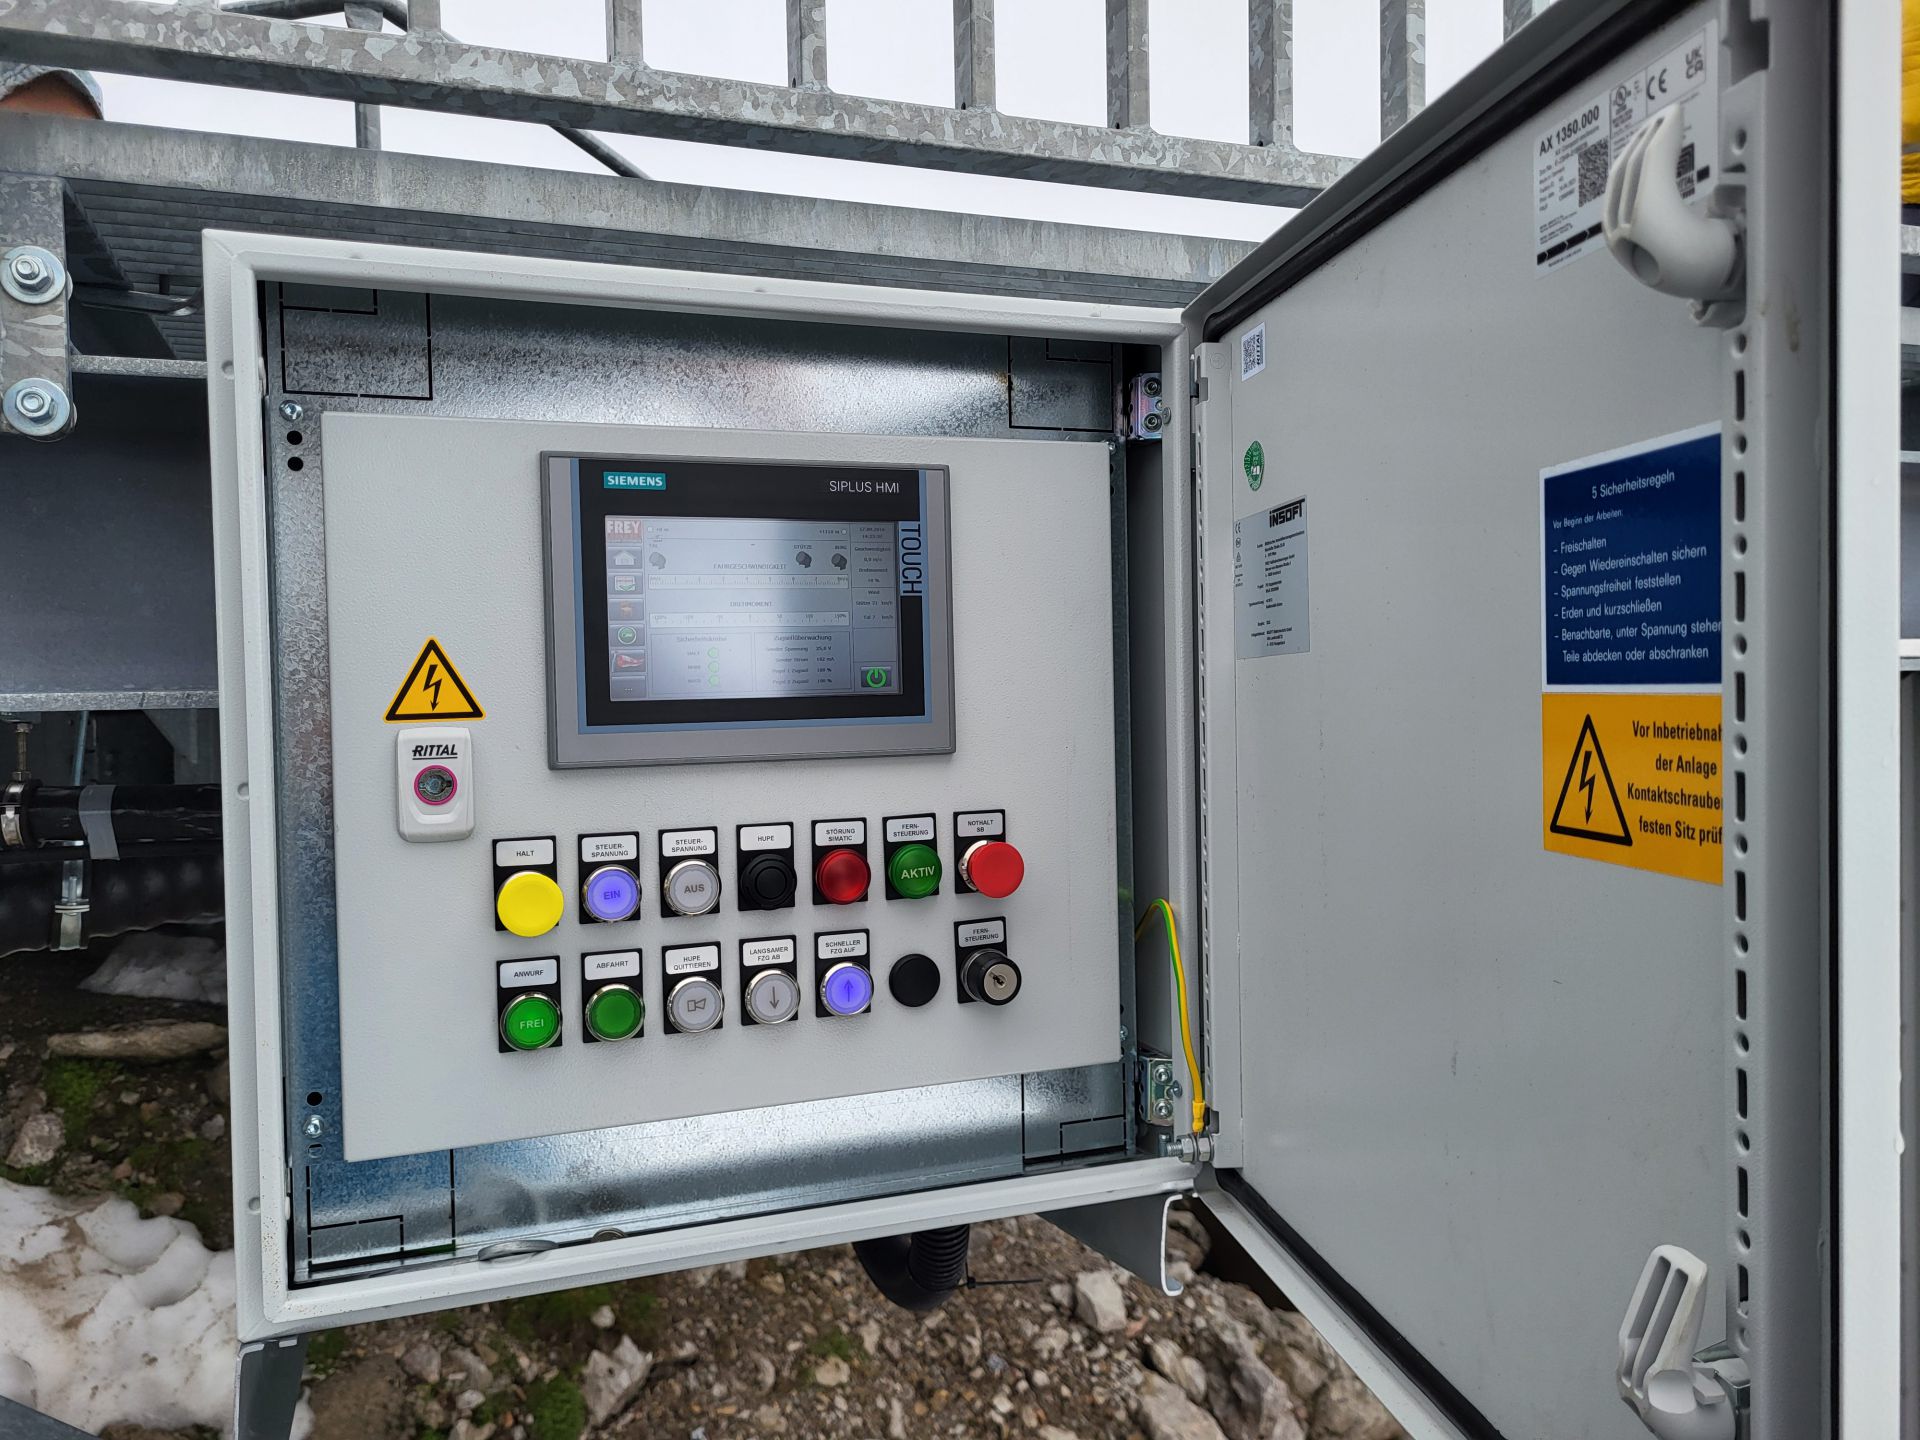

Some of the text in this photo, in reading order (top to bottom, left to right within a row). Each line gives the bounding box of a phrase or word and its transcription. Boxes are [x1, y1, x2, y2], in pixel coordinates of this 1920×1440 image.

[1647, 69, 1667, 100] CE
[1540, 136, 1552, 156] AX
[1556, 105, 1599, 144] 1350.000
[608, 475, 663, 488] SIEMENS
[830, 480, 900, 493] SIPLUS HMI
[1592, 469, 1675, 499] 5 Sicherheitsregeln
[1553, 508, 1624, 529] Vor Beginn der Arbeiten:
[607, 520, 641, 534] FREY
[1560, 538, 1606, 554] Freischalten
[902, 523, 922, 595] TOUCH
[1561, 544, 1707, 578] Gegen Wiedereinschalten sichern
[1561, 572, 1681, 600] Spannungsfreiheit feststellen
[1562, 599, 1662, 619] Erden und kurzschließen
[1562, 628, 1613, 641] Benachbarte,
[1616, 626, 1637, 638] unter
[1641, 622, 1687, 640] Spannung
[1563, 645, 1708, 662] Teile abdecken oder abschranken
[1632, 720, 1650, 738] Vor
[412, 744, 458, 756] RITTAL
[1656, 754, 1717, 779] der Anlage
[1627, 783, 1722, 810] Kontaktschraube
[826, 827, 855, 835] STÖRUNG
[893, 829, 928, 837] STEUERUNG
[1639, 816, 1671, 836] festen
[1675, 820, 1696, 841] Sitz
[591, 850, 628, 858] SPANNUNG
[672, 845, 707, 853] SPANNUNG
[901, 866, 935, 880] AKTIV
[604, 890, 621, 900] EIN
[684, 884, 704, 894] AUS
[825, 940, 860, 948] SCHNELLER
[964, 933, 999, 942] STEUERUNG
[750, 947, 788, 955] LANGSAMER
[596, 960, 628, 968] ABFAHRT
[674, 961, 711, 971] QUITTIEREN
[514, 970, 544, 978] ANWURF
[520, 1019, 544, 1030] FREI
